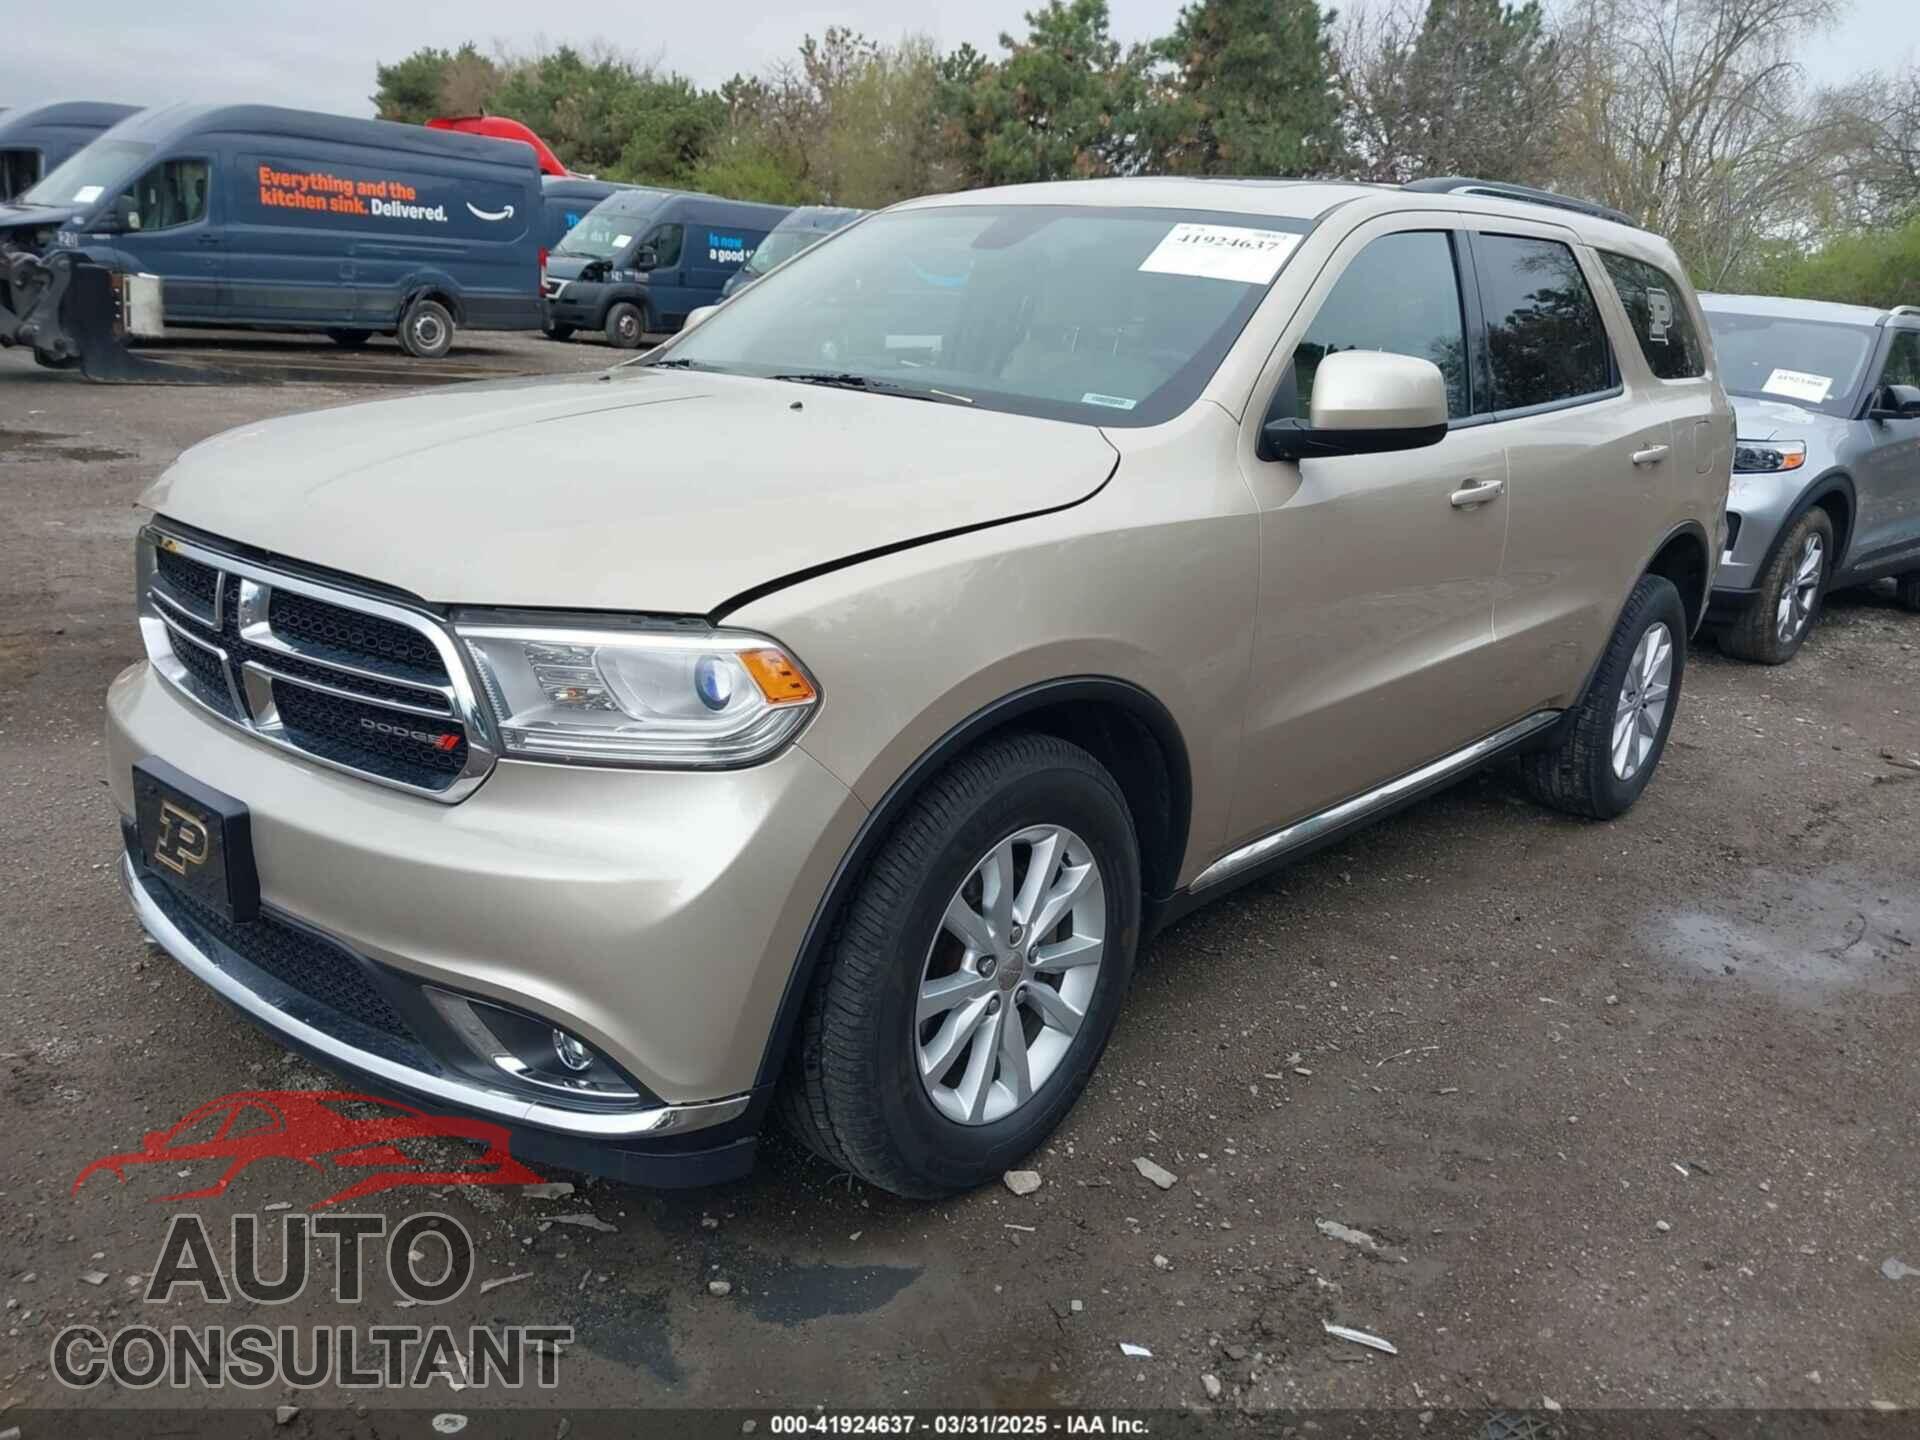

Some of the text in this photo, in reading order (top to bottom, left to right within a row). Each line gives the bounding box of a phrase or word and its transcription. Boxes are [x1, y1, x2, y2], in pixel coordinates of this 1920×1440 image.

[259, 165, 416, 200] Everything and the
[260, 187, 448, 222] kitchen sink. Delivered.
[709, 248, 717, 260] a
[718, 248, 745, 263] good
[1177, 234, 1280, 251] 41924637
[360, 718, 441, 745] DODGE
